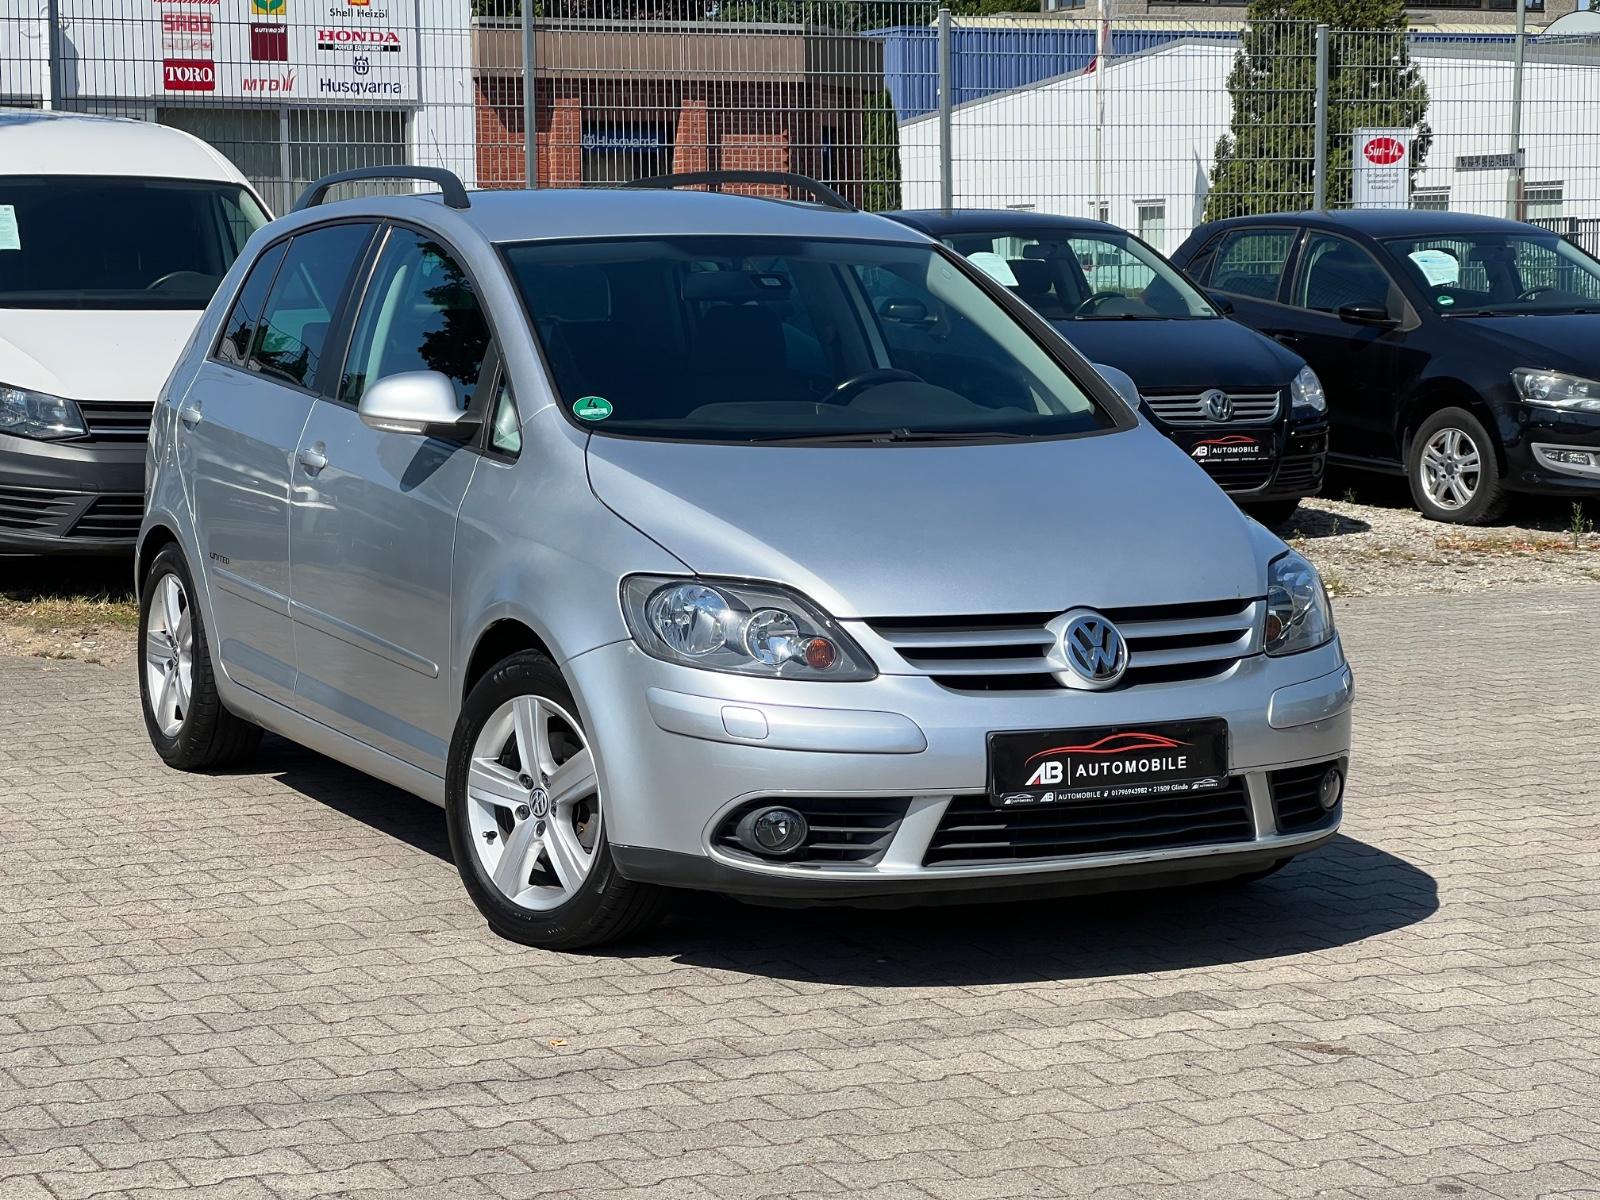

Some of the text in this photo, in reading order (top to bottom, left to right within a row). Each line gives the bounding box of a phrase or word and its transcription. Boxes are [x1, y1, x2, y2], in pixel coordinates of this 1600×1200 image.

[329, 8, 388, 19] Shell Heizöl
[163, 14, 212, 33] SABO
[317, 29, 400, 43] HONDA
[165, 66, 213, 82] TORO
[243, 79, 280, 91] MTD
[320, 77, 402, 96] Husqvarna
[597, 136, 658, 150] Husqvarna
[586, 397, 598, 409] 4
[1191, 445, 1260, 457] AB AUTOMOBILE
[1024, 755, 1188, 786] AB AUTOMOBILE
[1058, 790, 1101, 801] AUTOMOBILE
[1153, 784, 1171, 793] 21509
[1171, 783, 1189, 791] Glinde
